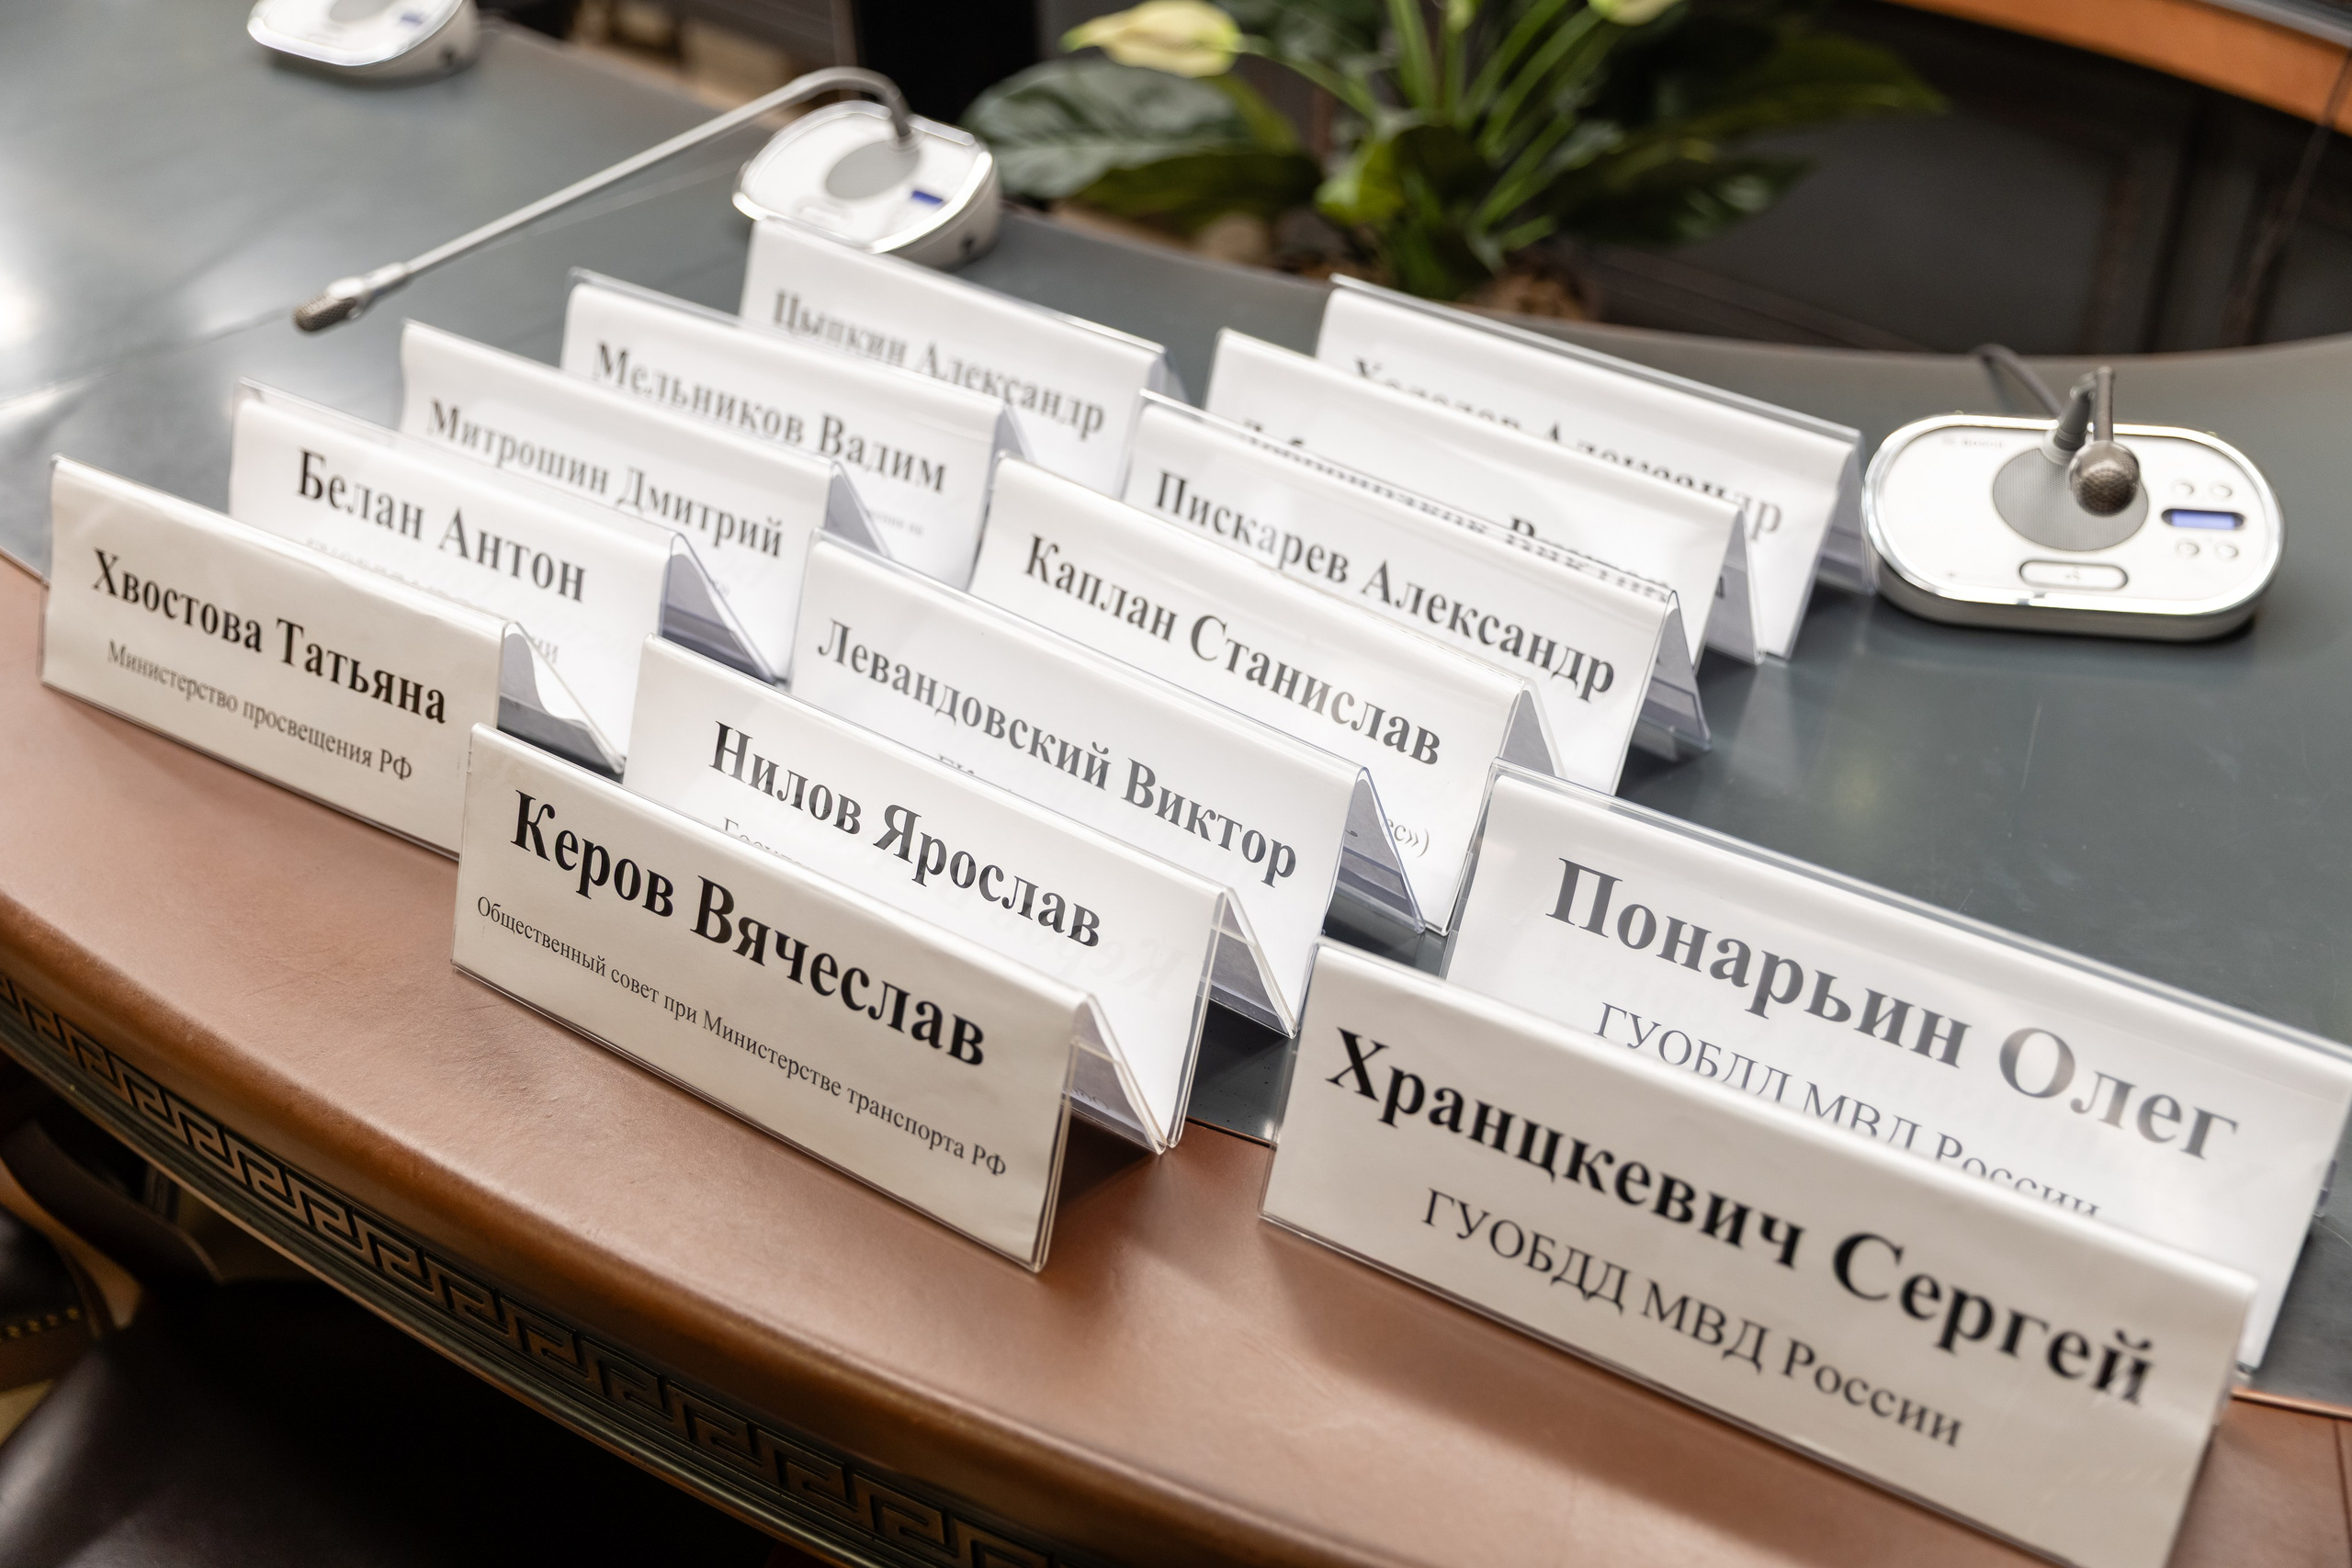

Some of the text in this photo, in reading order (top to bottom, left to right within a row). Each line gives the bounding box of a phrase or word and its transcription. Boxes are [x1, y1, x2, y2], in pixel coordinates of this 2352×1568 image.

[427, 398, 784, 559] Митрошин Дмитрий
[594, 340, 946, 493] Мельников Вадим
[915, 341, 1105, 441] Александр
[93, 546, 262, 652] Хвостова
[276, 617, 447, 725] Татьяна
[297, 448, 425, 540] Белан
[438, 506, 587, 604] Антон
[1154, 470, 1350, 584] Пискарев
[1361, 558, 1615, 703] Александр
[107, 638, 413, 782] Министерство просвещения РФ
[818, 618, 1296, 888] Левандовский Виктор
[1024, 533, 1442, 766] Каплан Станислав
[510, 789, 986, 1066] Керов Вячеслав
[708, 720, 1101, 947] Нилов Ярослав
[476, 895, 1008, 1179] Общественный совет при Министерстве транспорта РФ
[1545, 857, 2239, 1161] Понарьин Олег
[1326, 1026, 2153, 1408] Хранцкевич Сергей
[1421, 1188, 1962, 1449] ГУОБДД МВД России
